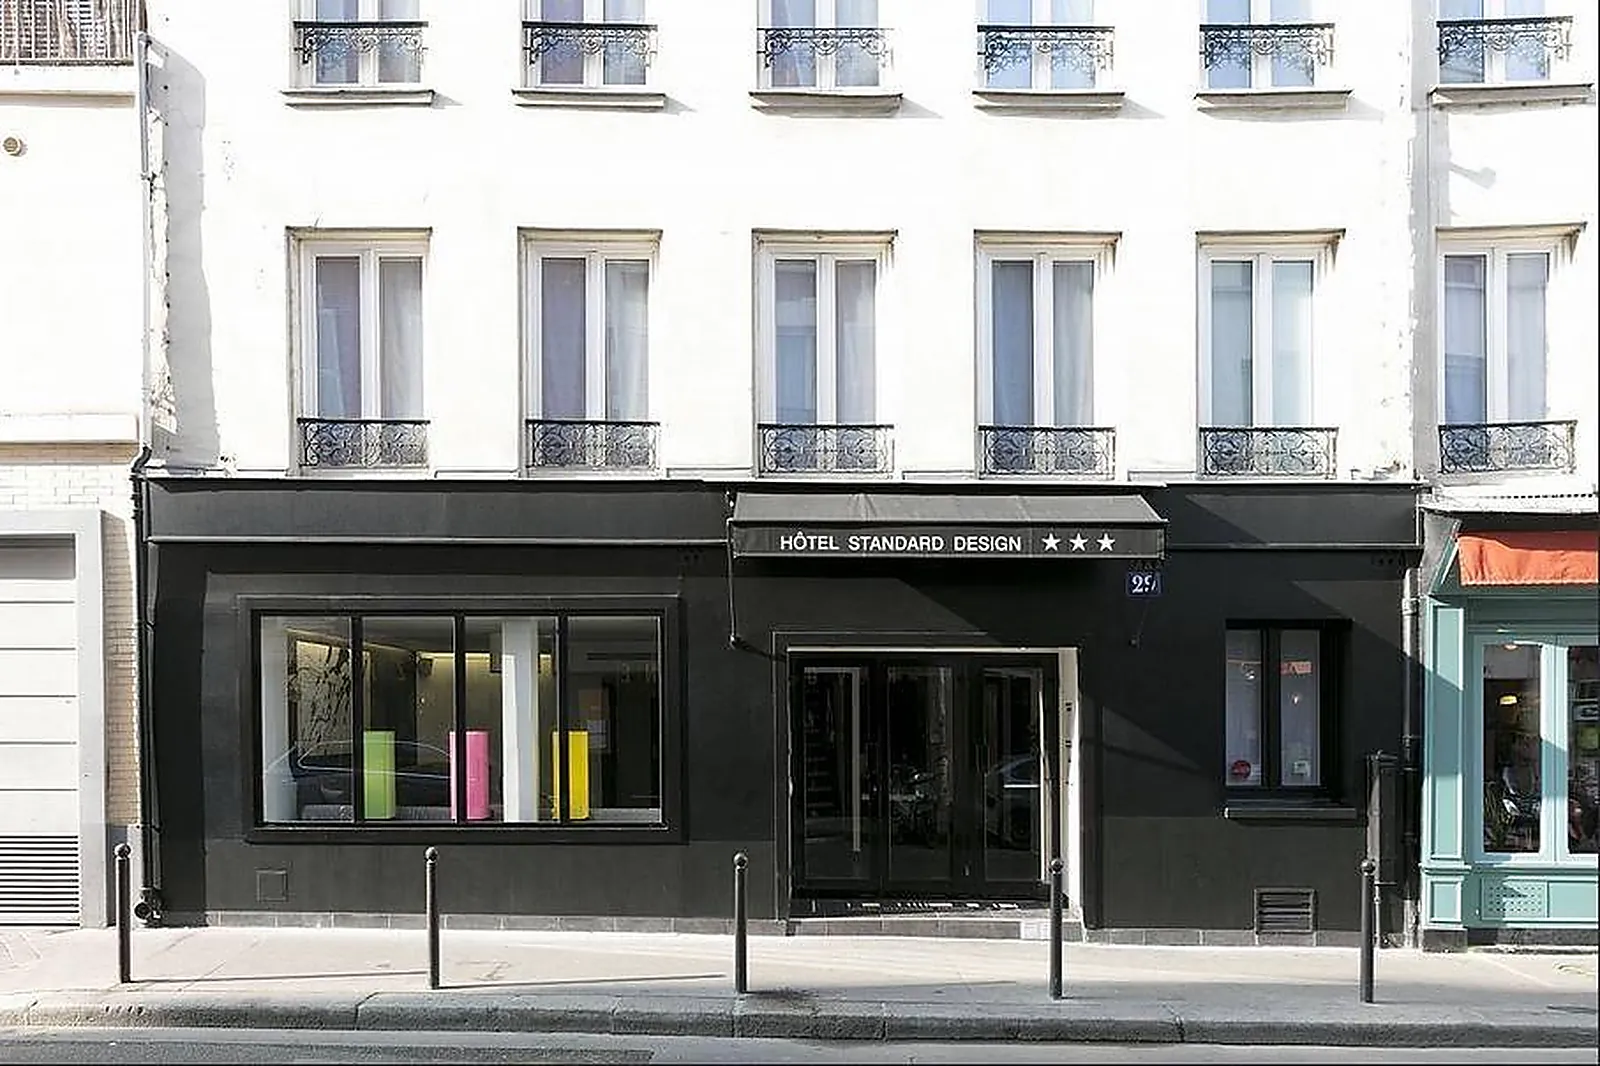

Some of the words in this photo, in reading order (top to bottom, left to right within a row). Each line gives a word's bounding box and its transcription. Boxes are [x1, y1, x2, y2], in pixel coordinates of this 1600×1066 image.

[780, 531, 840, 550] HÔTEL
[848, 535, 945, 551] STANDARD
[953, 535, 1022, 552] DESIGN
